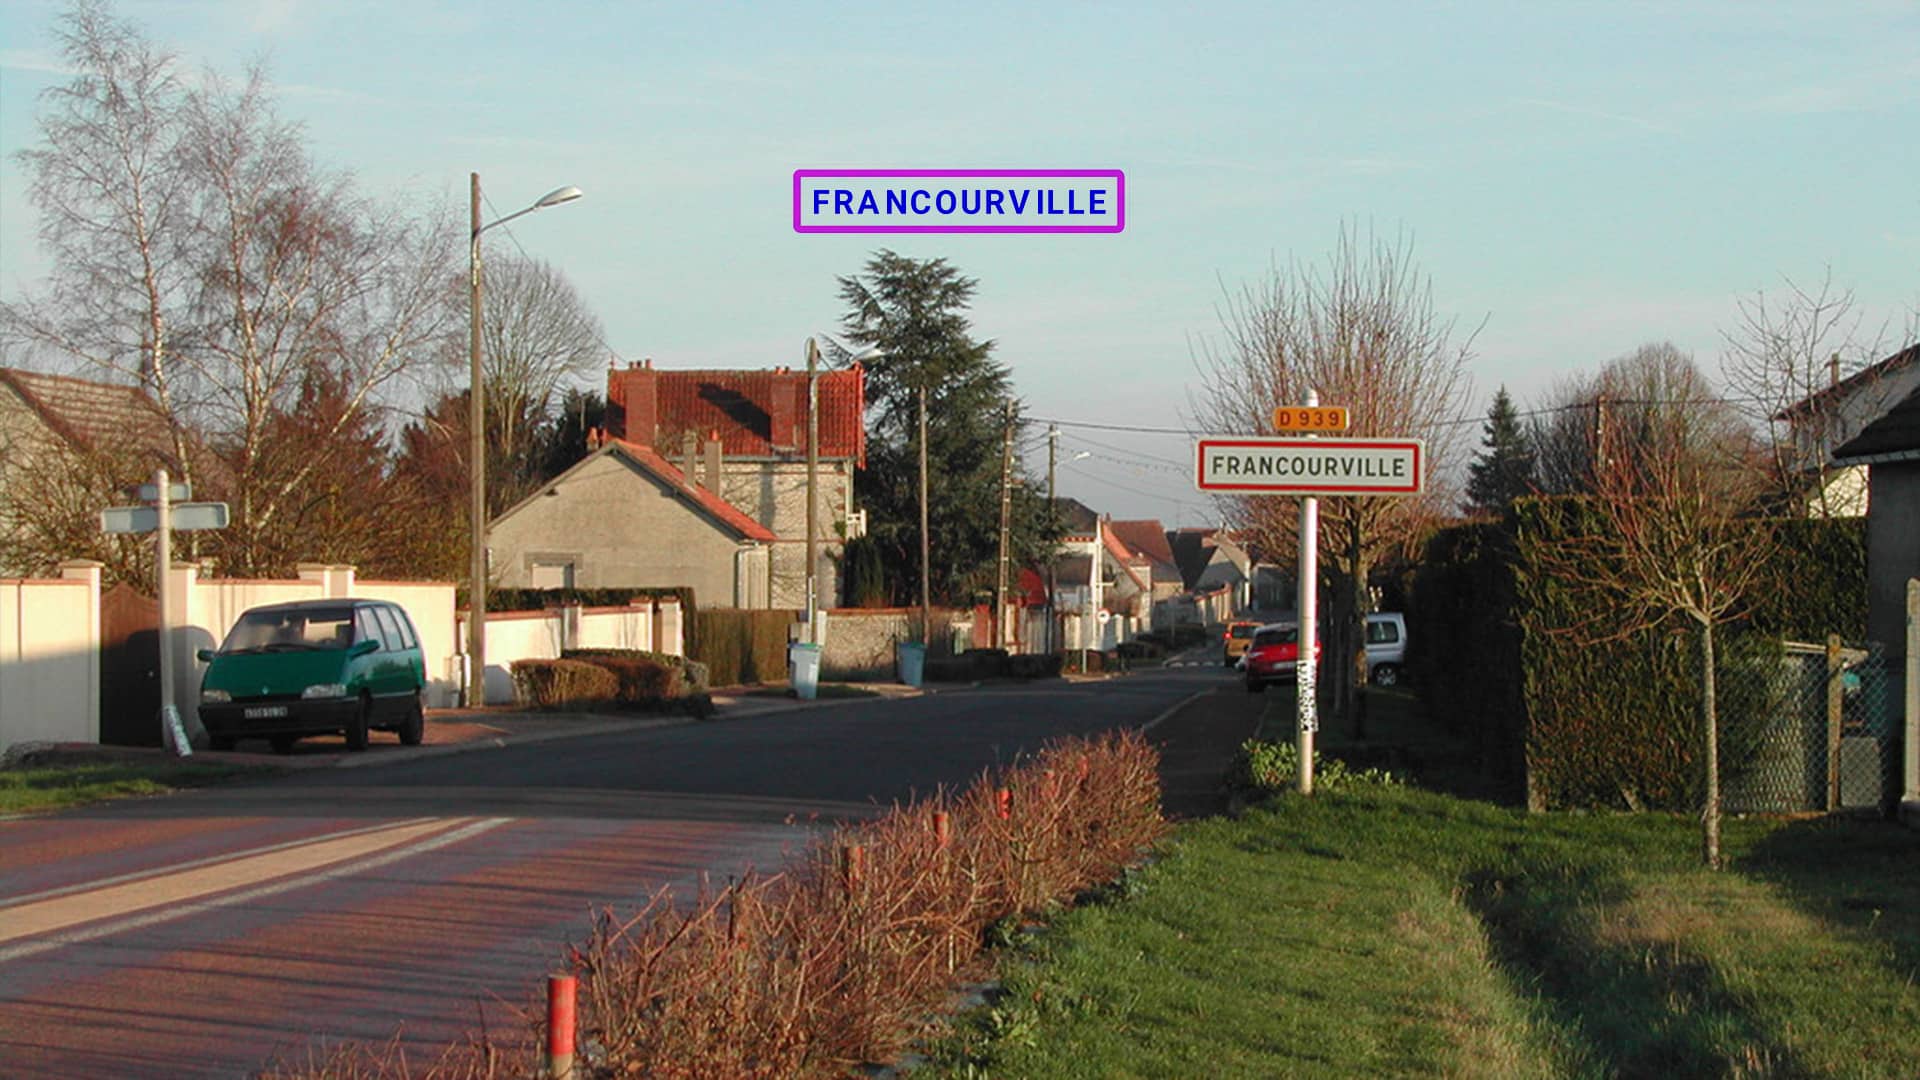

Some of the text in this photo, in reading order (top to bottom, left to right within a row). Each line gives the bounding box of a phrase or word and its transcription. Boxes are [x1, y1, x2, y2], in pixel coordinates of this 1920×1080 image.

[1279, 410, 1340, 426] D 939
[1212, 456, 1405, 477] FRANCOURVILLE
